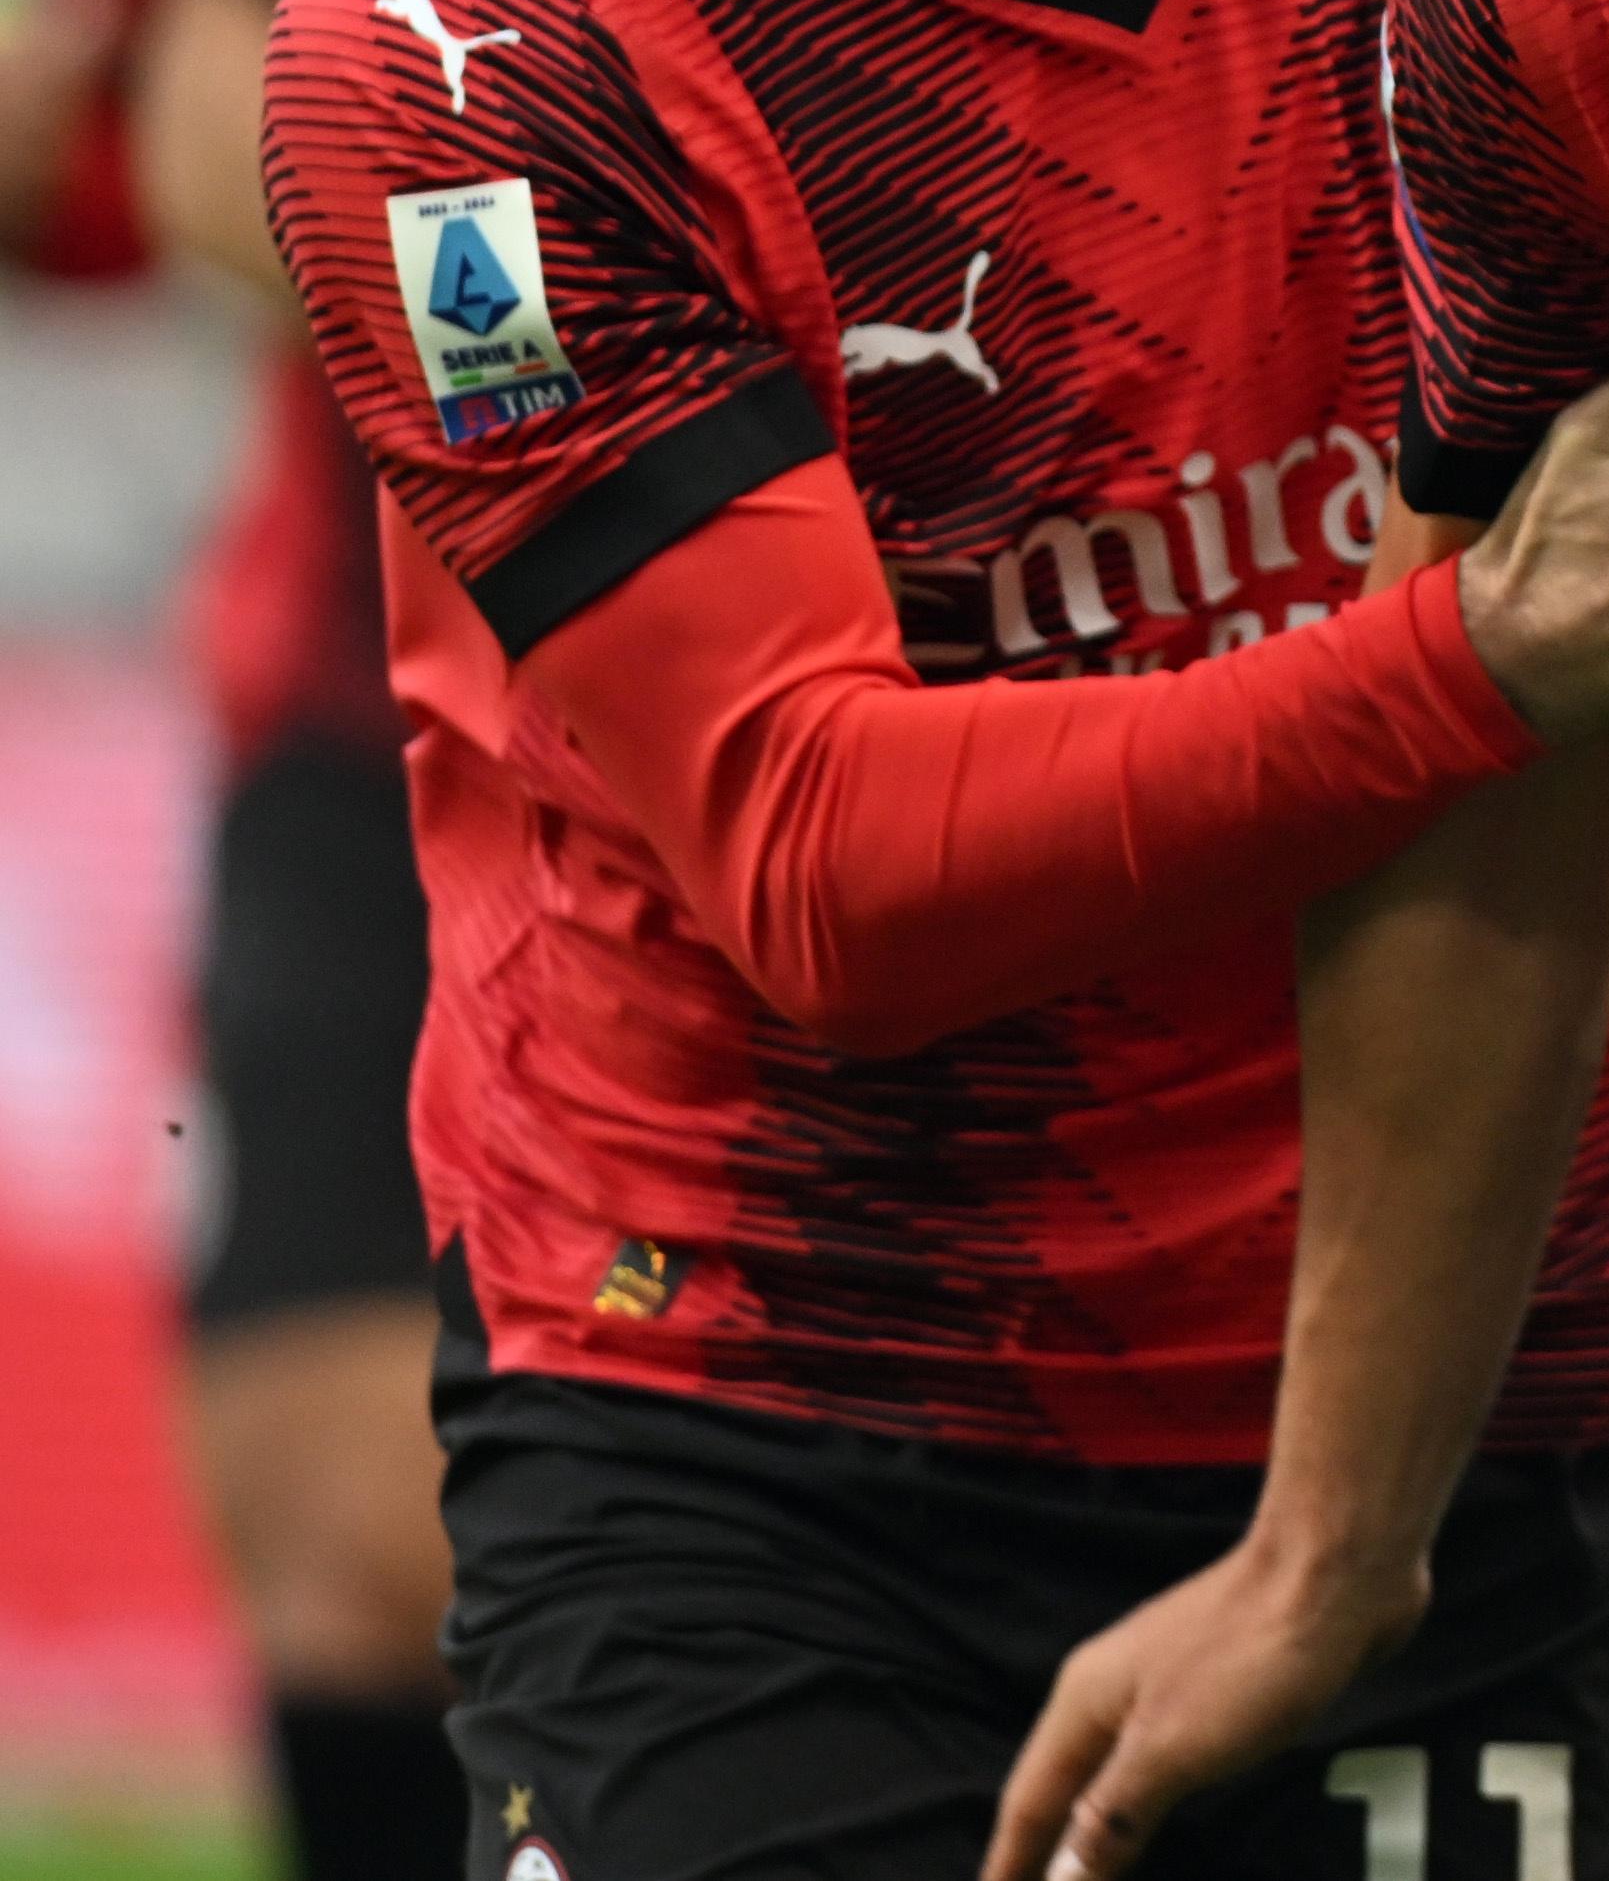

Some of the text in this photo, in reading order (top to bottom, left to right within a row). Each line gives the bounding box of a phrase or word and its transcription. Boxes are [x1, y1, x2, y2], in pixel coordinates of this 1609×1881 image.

[441, 338, 543, 373] SERIE A
[501, 382, 567, 420] TIM
[1323, 1740, 1576, 1881] 11
